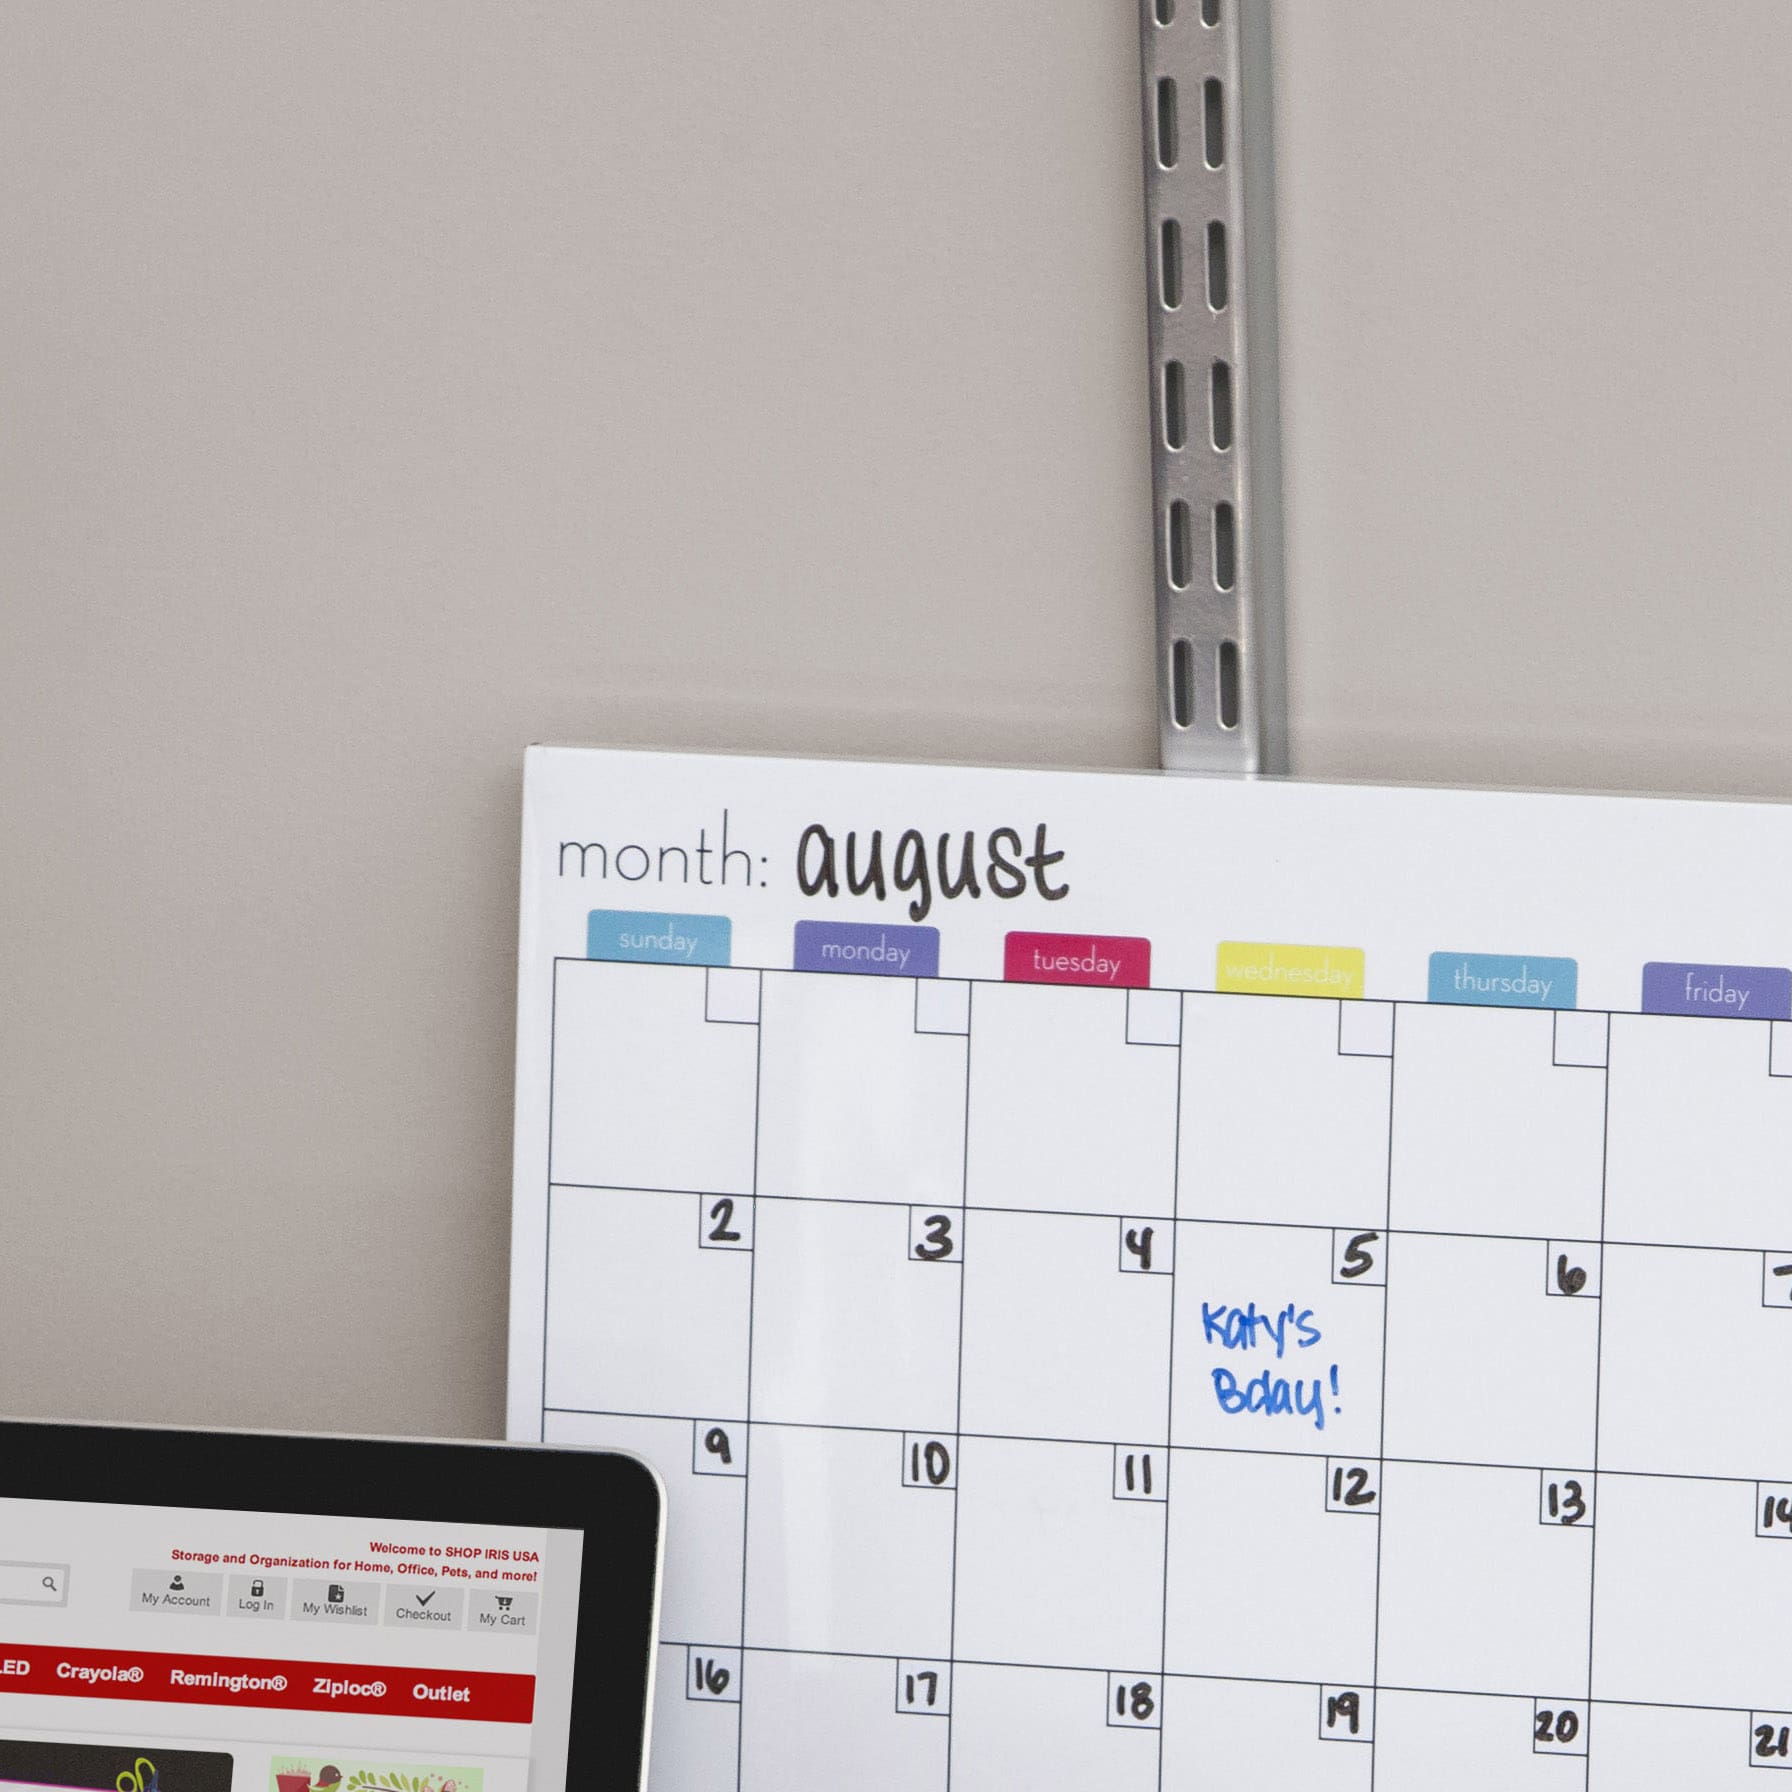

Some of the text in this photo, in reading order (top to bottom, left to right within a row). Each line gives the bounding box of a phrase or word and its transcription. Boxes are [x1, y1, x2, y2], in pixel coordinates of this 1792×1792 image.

[557, 808, 768, 888] month:
[796, 822, 1070, 922] august
[618, 928, 698, 958] sunday
[821, 937, 911, 968] monday
[1032, 949, 1121, 979] tuesday
[1226, 951, 1354, 993] wednesday
[1453, 968, 1553, 1002] thursday
[1684, 977, 1751, 1010] friday
[709, 1199, 741, 1242] 2
[915, 1215, 954, 1259] 3
[1125, 1227, 1154, 1270] 4
[1340, 1232, 1379, 1278] 5
[1557, 1255, 1587, 1296] 6
[1202, 1302, 1321, 1358] Katy's
[1211, 1364, 1341, 1430] Bday!
[705, 1428, 733, 1465] 9
[909, 1441, 950, 1484] 10
[1126, 1455, 1153, 1495] 11
[1331, 1468, 1377, 1507] 12
[1548, 1482, 1587, 1524] 13
[171, 1549, 538, 1583] Storage and Organization for Home, Office, Pets, and more!
[370, 1542, 539, 1563] Welcome to SHOP IRIS USA
[142, 1592, 211, 1608] My Account
[239, 1598, 274, 1613] Log In
[303, 1602, 368, 1618] My Wishlist
[396, 1608, 452, 1623] Checkout
[479, 1613, 526, 1628] My Cart
[413, 1684, 470, 1702] Outlet
[695, 1657, 730, 1695] 16
[905, 1672, 938, 1705] 17
[1116, 1682, 1155, 1720] 18
[1326, 1693, 1361, 1733] 19
[1536, 1710, 1579, 1744] 20
[1755, 1726, 1789, 1758] 21
